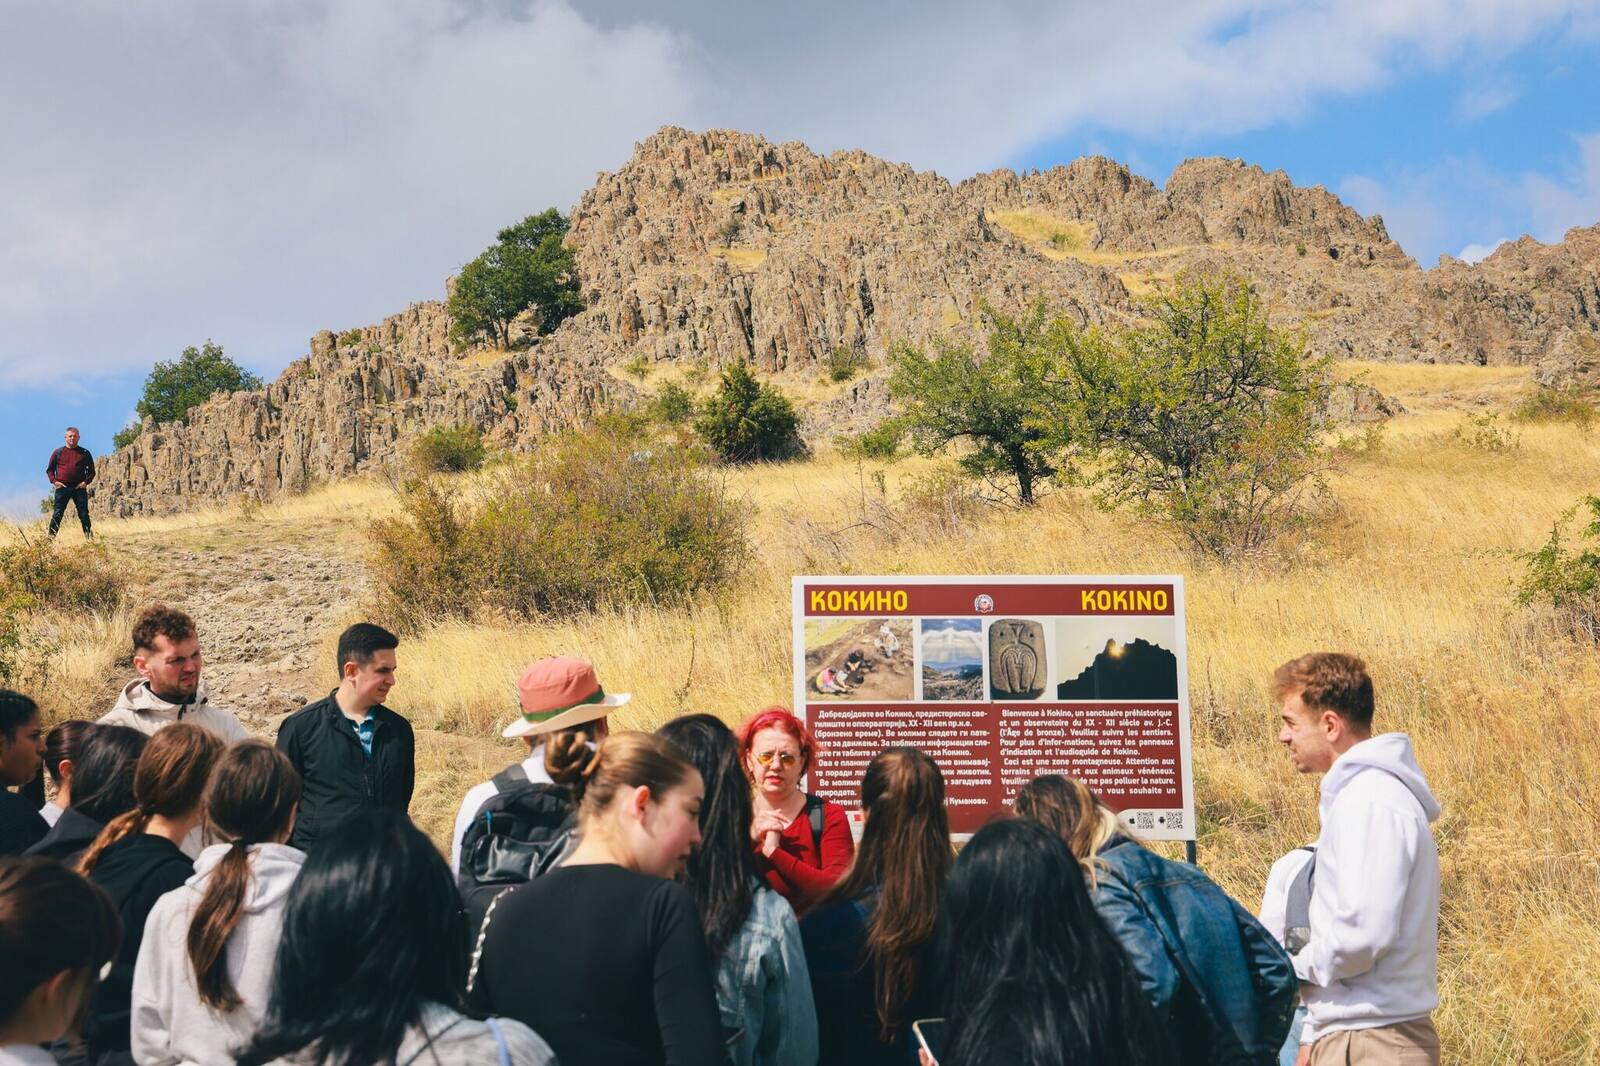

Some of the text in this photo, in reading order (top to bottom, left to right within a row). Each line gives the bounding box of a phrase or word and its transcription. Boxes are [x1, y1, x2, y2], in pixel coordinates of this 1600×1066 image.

[811, 590, 908, 611] КОКИНО
[1082, 590, 1167, 610] KOKINO
[1047, 709, 1074, 717] Kokino,
[1125, 709, 1172, 718] préhistorique
[1020, 739, 1034, 747] plus
[1114, 777, 1139, 786] polluer
